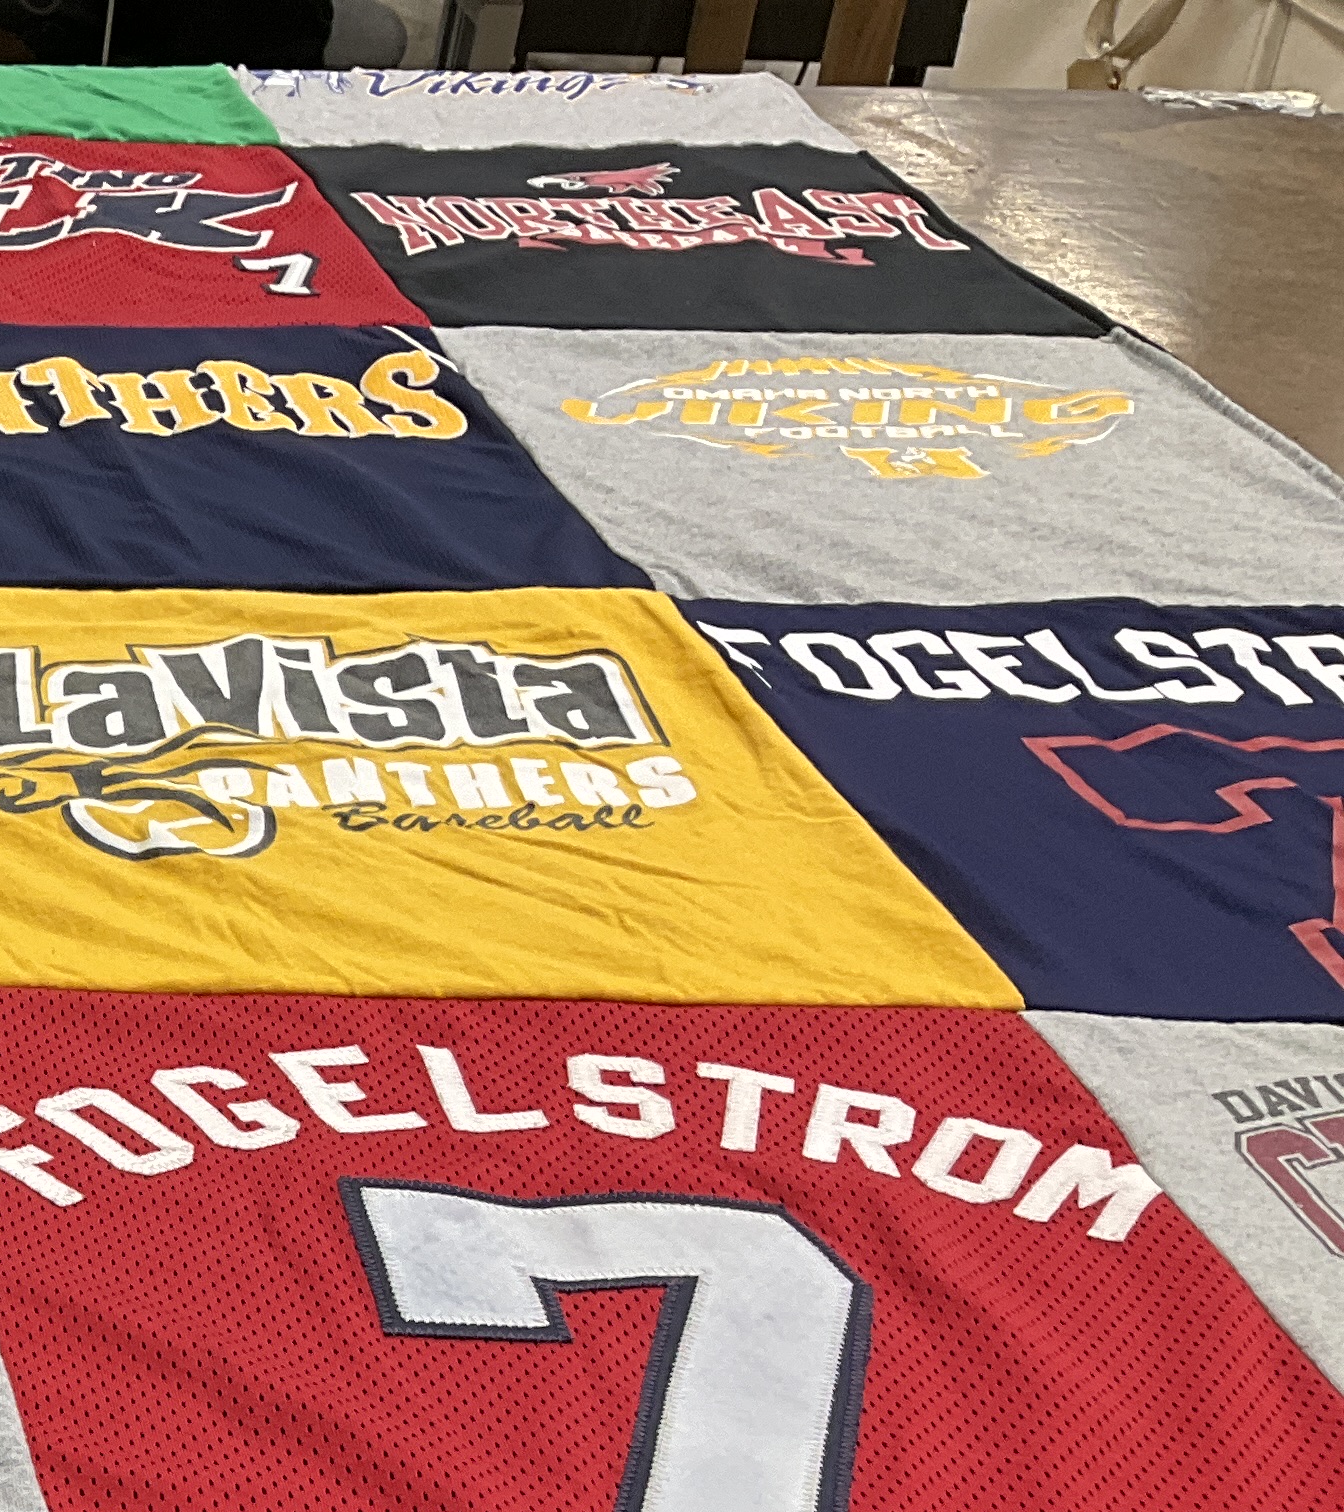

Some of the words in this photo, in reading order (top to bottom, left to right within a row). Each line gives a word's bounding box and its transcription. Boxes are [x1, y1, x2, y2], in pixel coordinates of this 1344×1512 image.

[350, 187, 972, 256] NORTHEAST
[233, 252, 321, 297] 7
[837, 385, 1000, 401] NORTH
[744, 424, 1024, 439] FOOTBALL
[196, 756, 698, 813] PANTHERS
[320, 802, 656, 833] Baseball
[1211, 1072, 1344, 1124] DAVI
